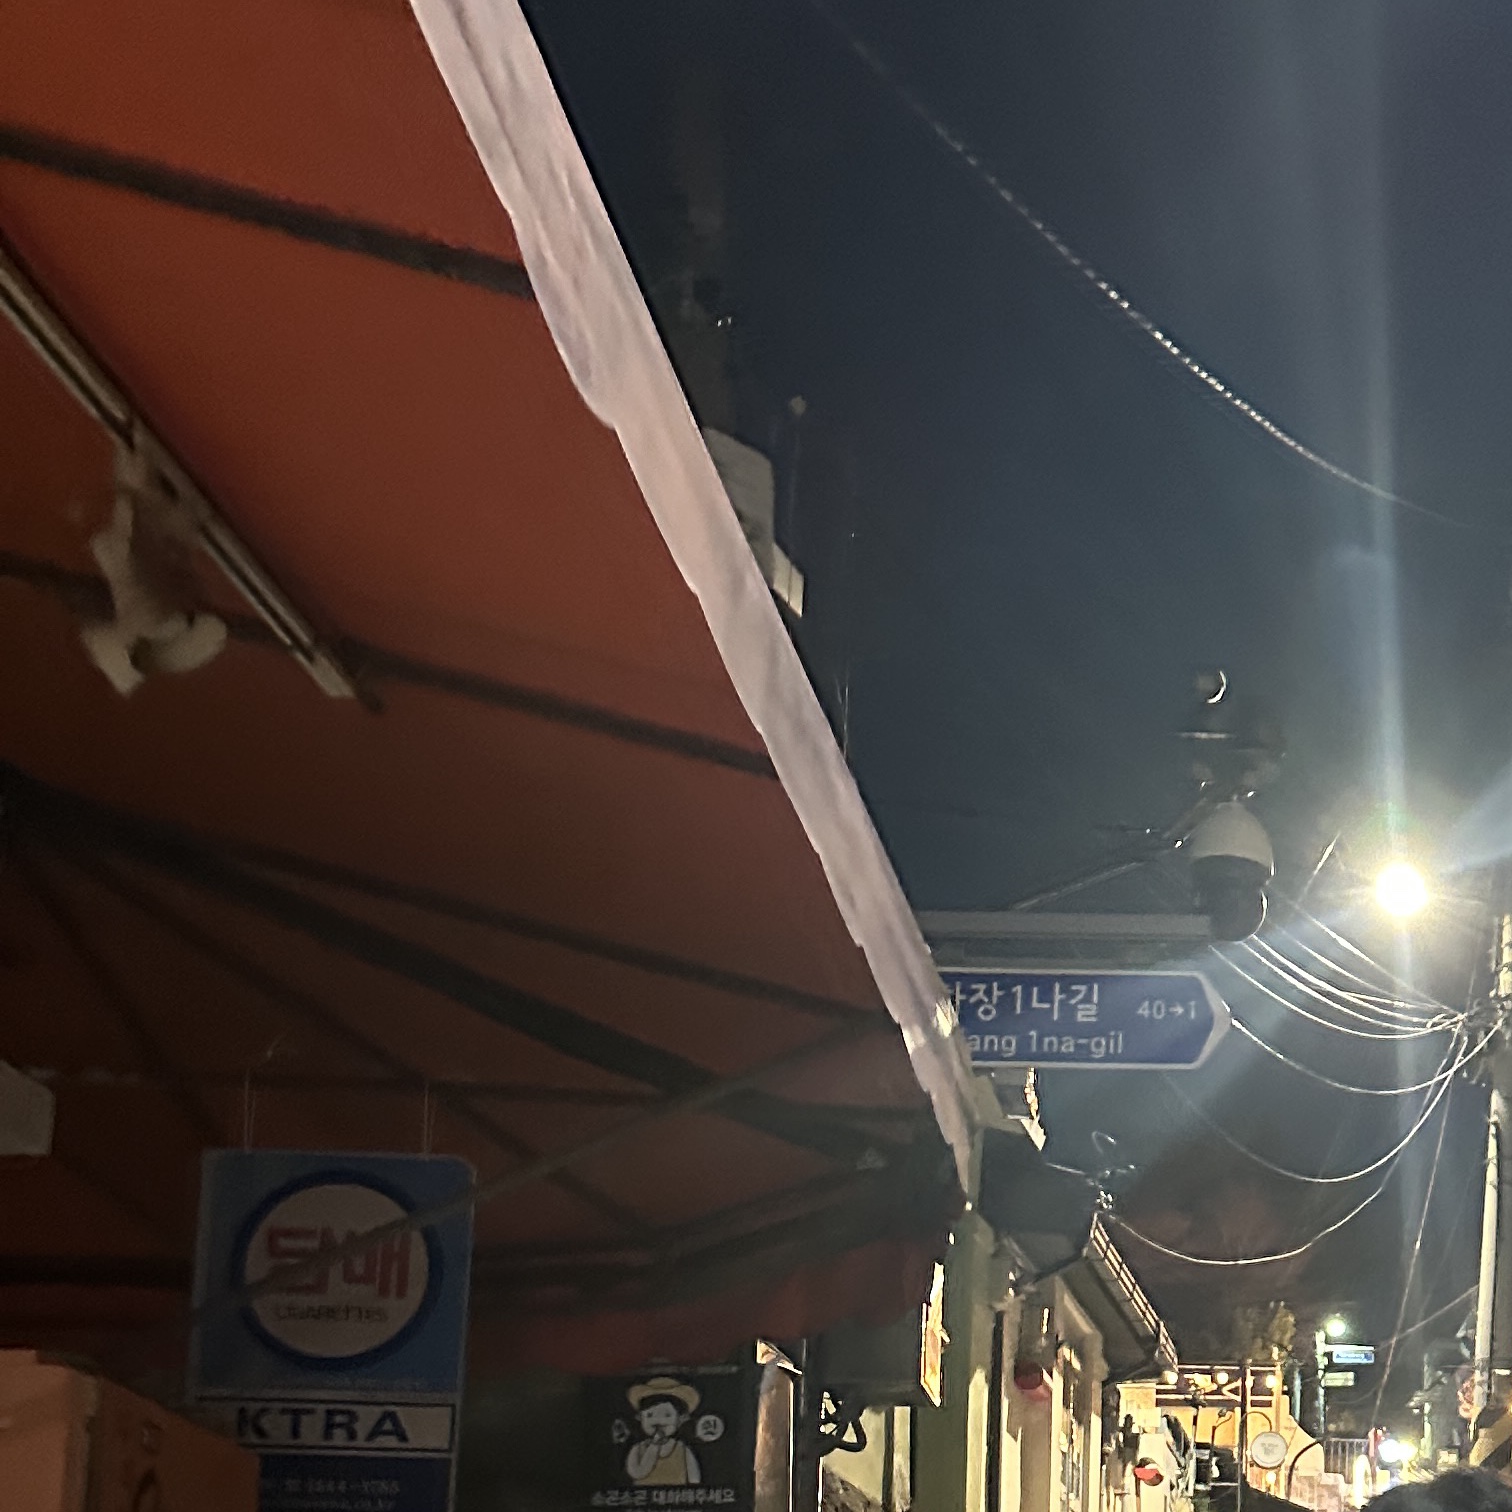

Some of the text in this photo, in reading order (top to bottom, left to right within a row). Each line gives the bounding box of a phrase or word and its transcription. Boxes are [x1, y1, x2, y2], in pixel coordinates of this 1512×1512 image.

[968, 1031, 1123, 1058] ang 1na-gil
[236, 1406, 409, 1442] KTRA
